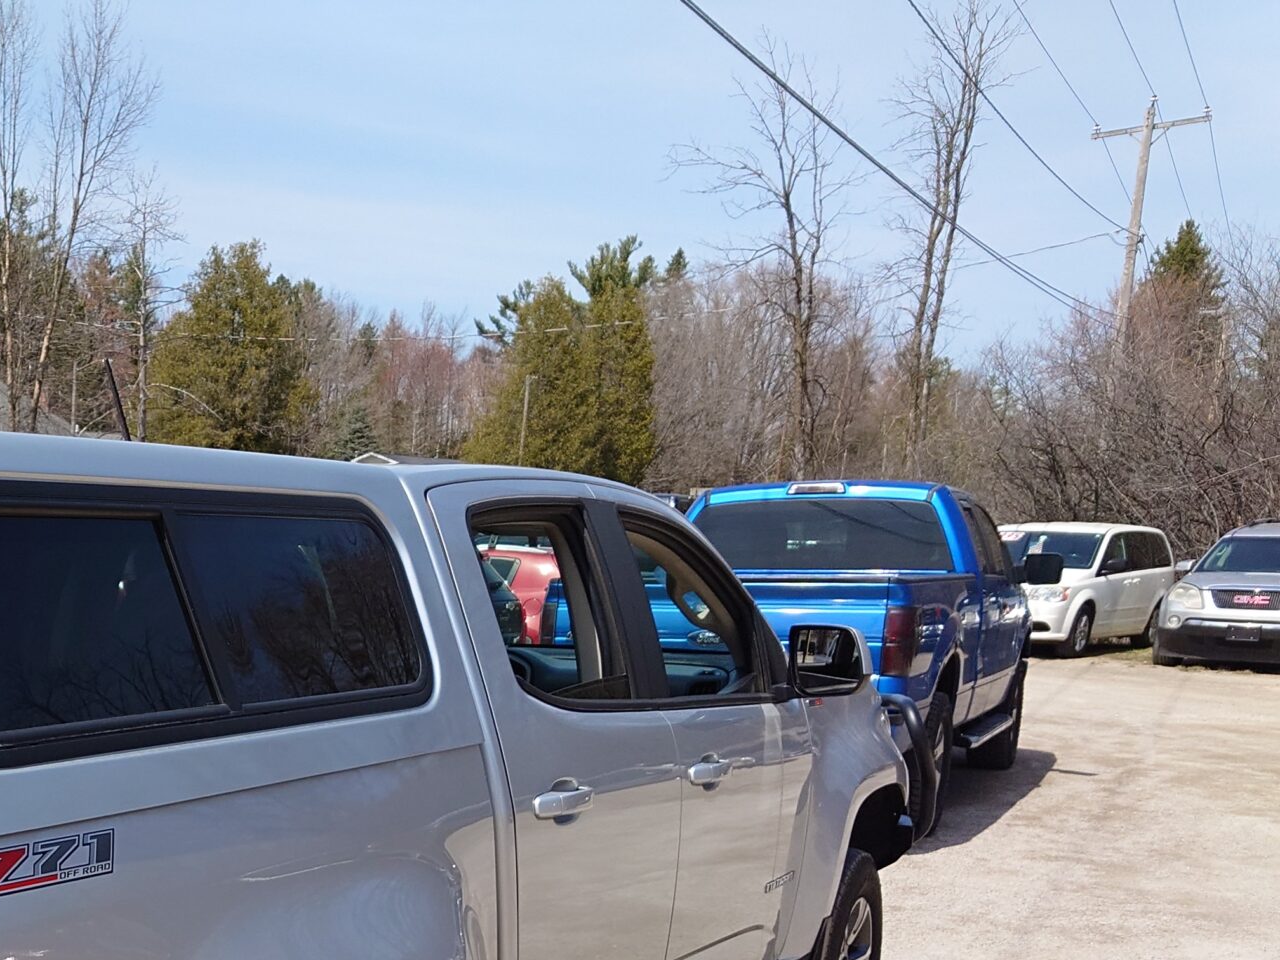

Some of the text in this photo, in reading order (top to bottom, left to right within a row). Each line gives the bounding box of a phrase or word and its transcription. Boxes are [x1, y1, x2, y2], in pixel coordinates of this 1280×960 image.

[1233, 594, 1271, 605] GMC
[59, 862, 111, 880] OFF ROAD
